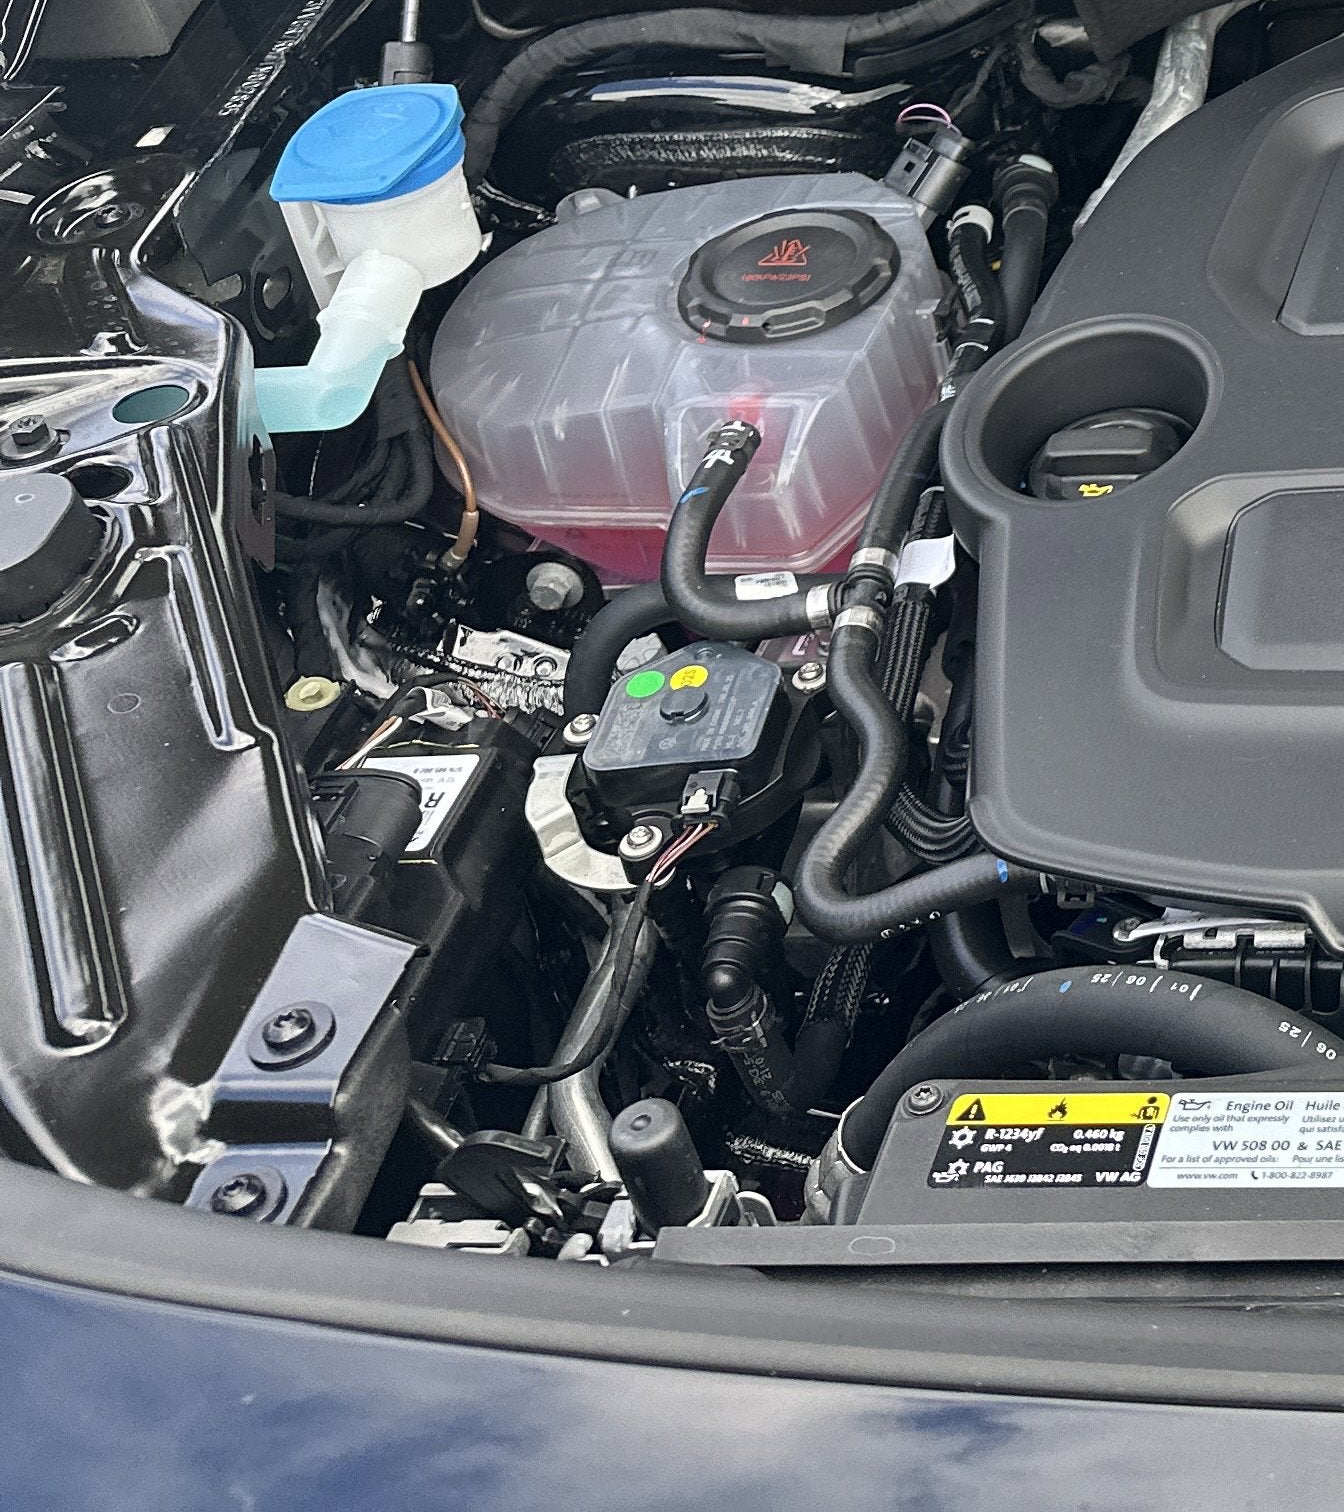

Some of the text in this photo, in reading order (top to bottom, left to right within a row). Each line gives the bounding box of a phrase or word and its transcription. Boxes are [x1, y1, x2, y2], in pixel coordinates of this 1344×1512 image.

[1226, 1100, 1294, 1113] Engine Oil
[1305, 1100, 1341, 1111] Huile
[1172, 1114, 1290, 1124] Use only oil that expressly
[1302, 1115, 1337, 1123] Utilisez
[1169, 1124, 1234, 1133] complies with
[1299, 1125, 1315, 1134] qui
[984, 1127, 1045, 1142] R-1234yf
[1212, 1140, 1238, 1151] VW
[1241, 1140, 1268, 1151] 508
[1271, 1140, 1292, 1151] 00
[1297, 1141, 1309, 1151] &
[1316, 1140, 1343, 1151] SAE
[1161, 1154, 1177, 1163] For
[1186, 1154, 1201, 1163] list
[1202, 1154, 1213, 1163] of
[1213, 1154, 1259, 1165] approved
[1292, 1154, 1314, 1163] Pour
[973, 1161, 1004, 1173] PAG
[984, 1174, 1003, 1183] SAE
[1095, 1171, 1142, 1183] VW AG
